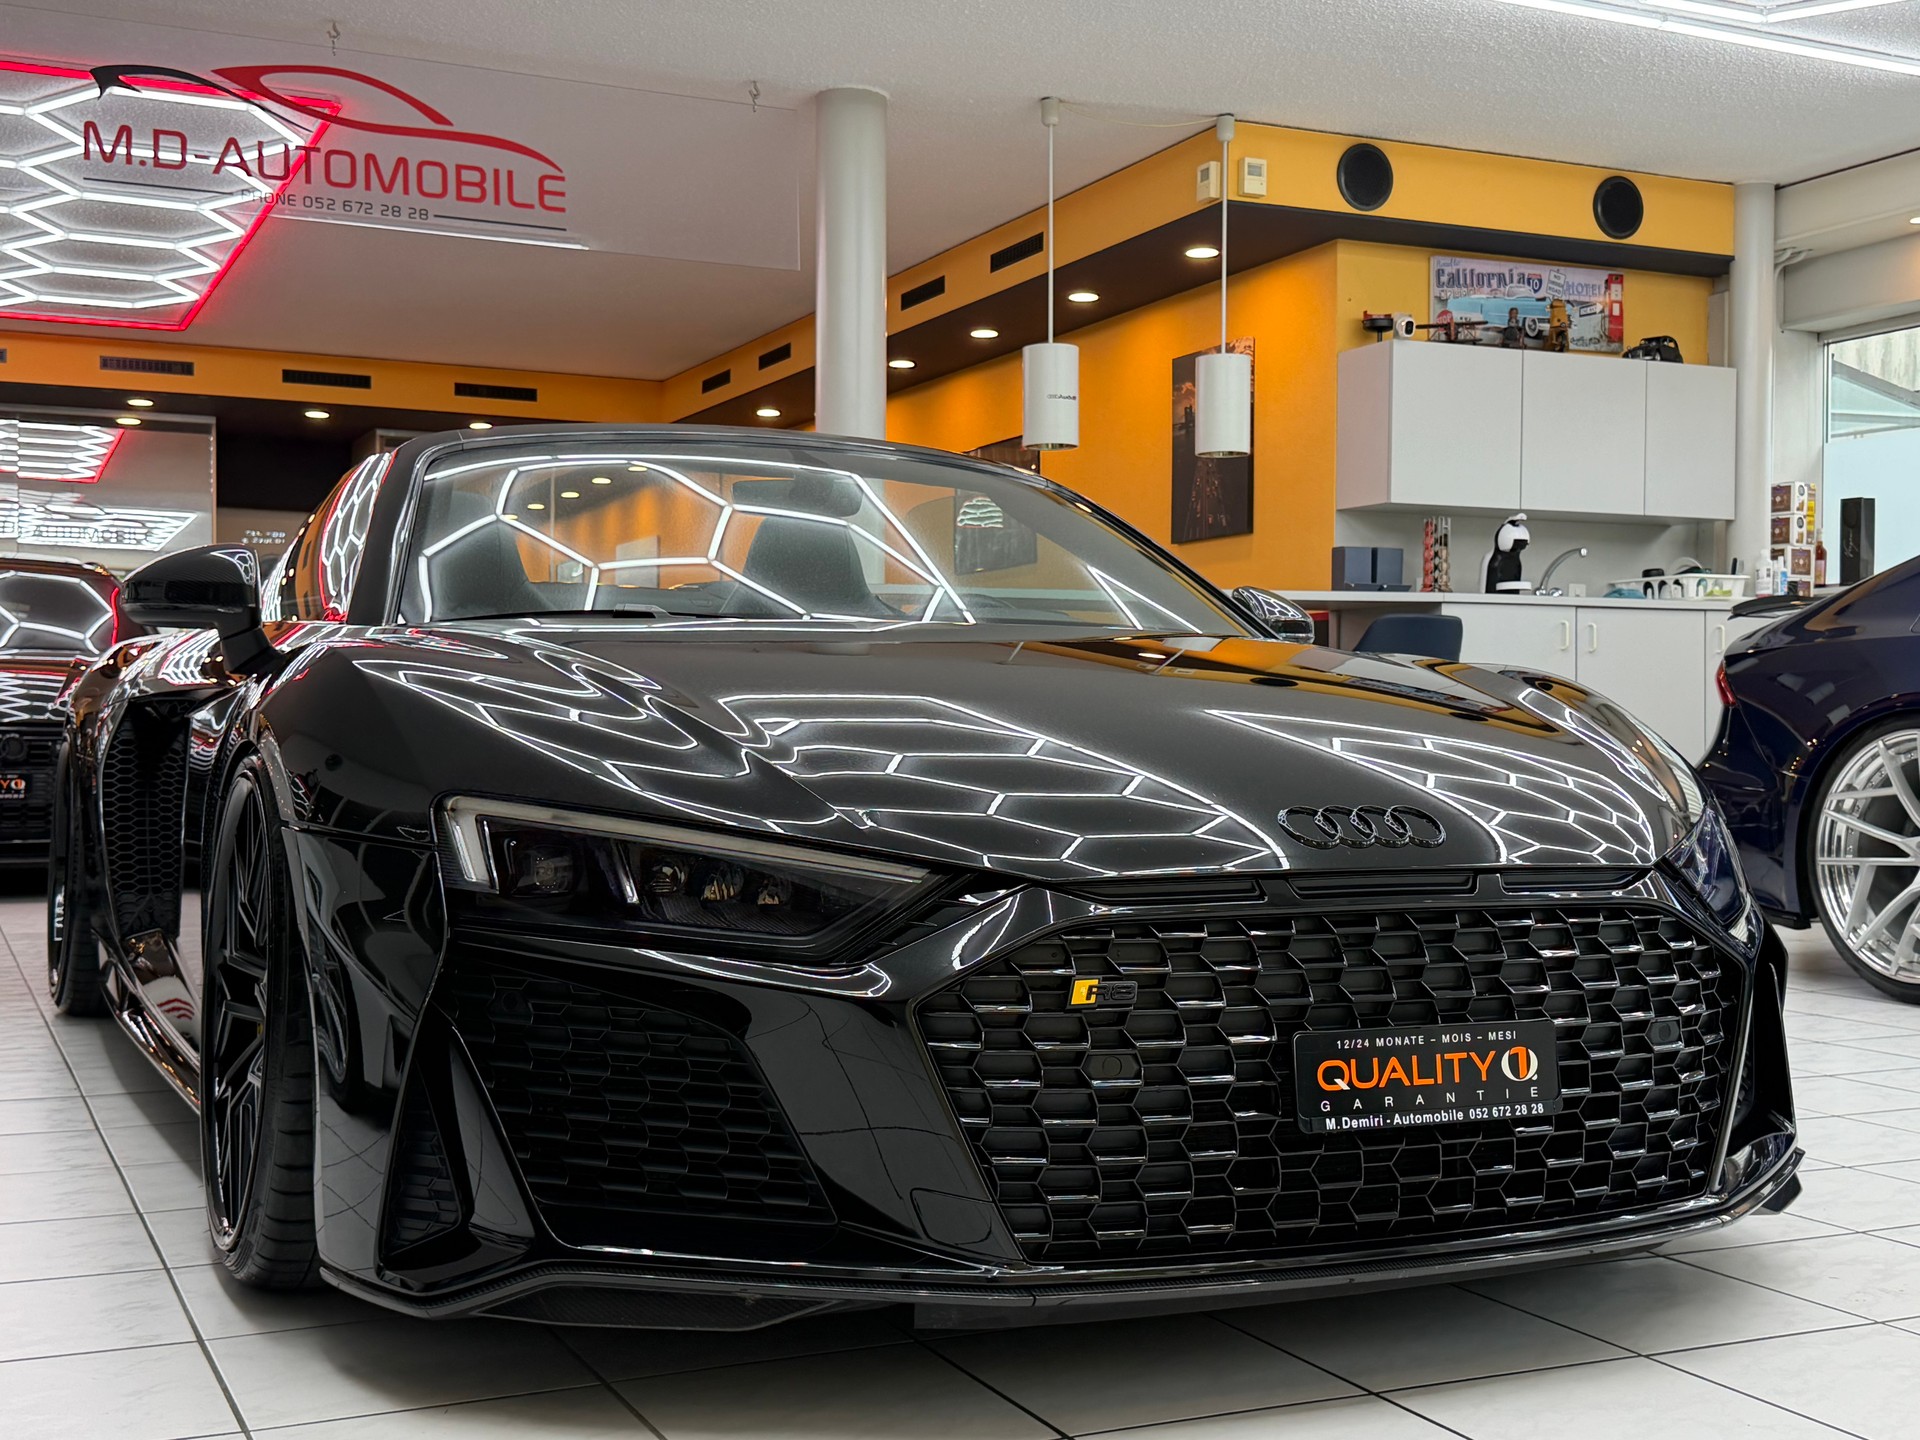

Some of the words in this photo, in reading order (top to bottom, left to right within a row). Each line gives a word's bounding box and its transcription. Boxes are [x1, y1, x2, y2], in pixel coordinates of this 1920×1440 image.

[83, 120, 567, 214] M.D-AUTOMOBILE
[242, 189, 297, 207] PHONE
[303, 195, 336, 211] 052
[342, 200, 373, 215] 672
[380, 203, 402, 218] 28
[408, 207, 429, 221] 28
[1436, 268, 1526, 289] California
[1336, 1038, 1370, 1049] 12/24
[1376, 1035, 1425, 1048] MONATE
[1441, 1032, 1472, 1043] MOIS
[1488, 1030, 1517, 1041] MESI
[1317, 1050, 1496, 1091] QUALITY
[1320, 1086, 1538, 1112] GARANTIE
[1469, 1107, 1489, 1120] 052
[1492, 1106, 1511, 1118] 672
[1515, 1105, 1528, 1116] 28
[1531, 1103, 1544, 1114] 28
